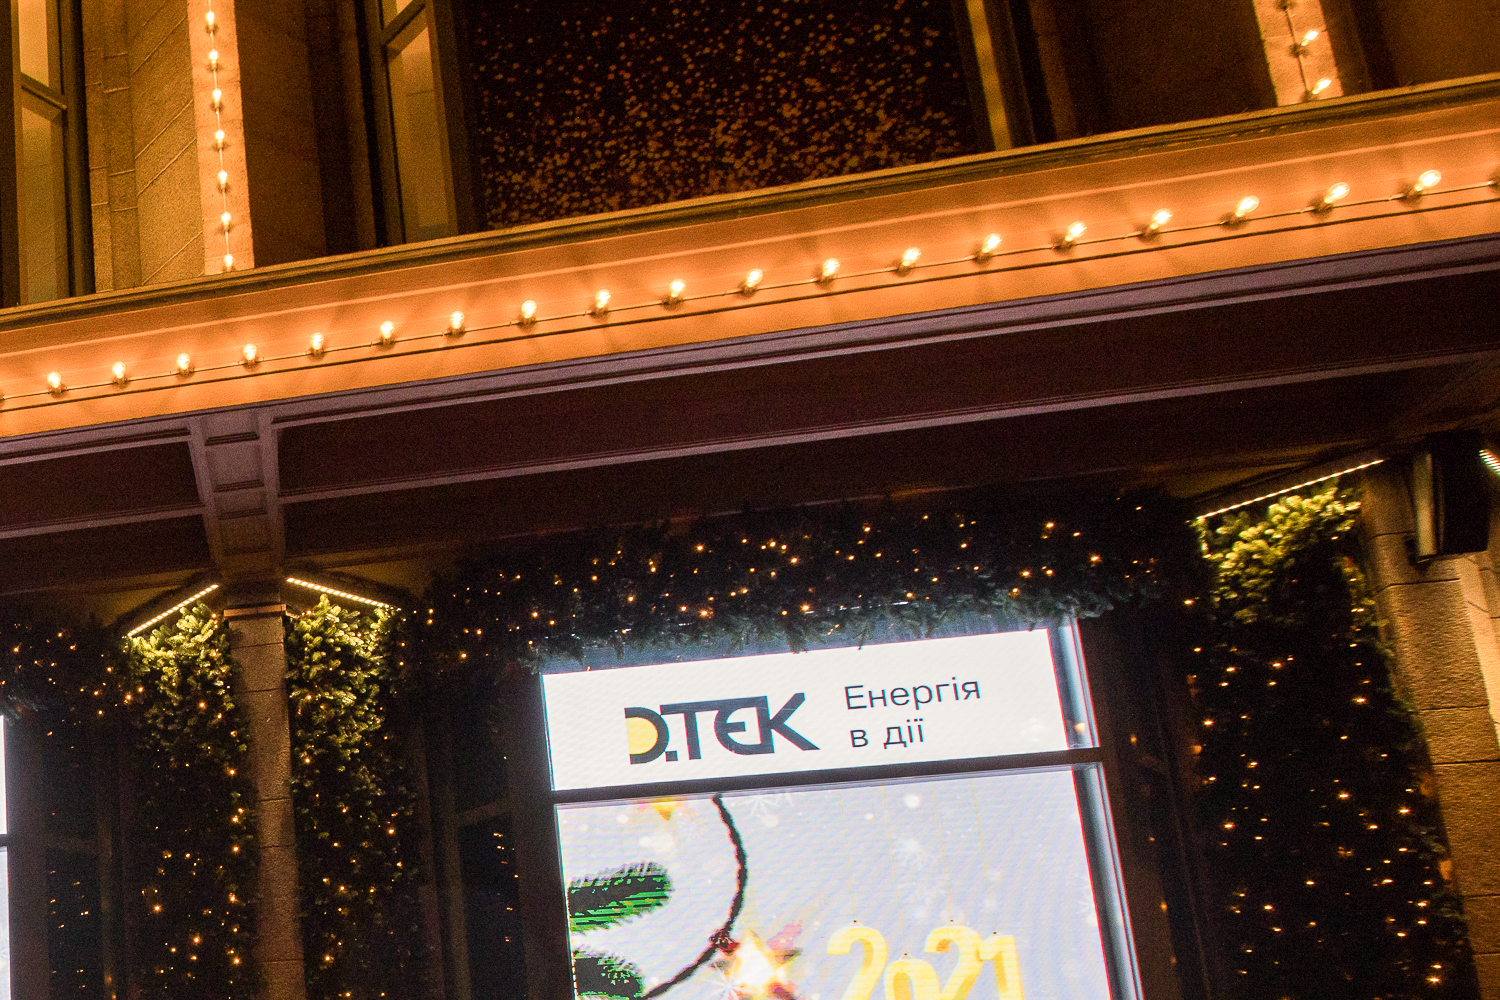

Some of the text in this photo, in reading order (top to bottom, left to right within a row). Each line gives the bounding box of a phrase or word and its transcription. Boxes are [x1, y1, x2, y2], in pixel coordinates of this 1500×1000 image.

[844, 676, 981, 711] Енергія
[849, 717, 925, 750] в дії
